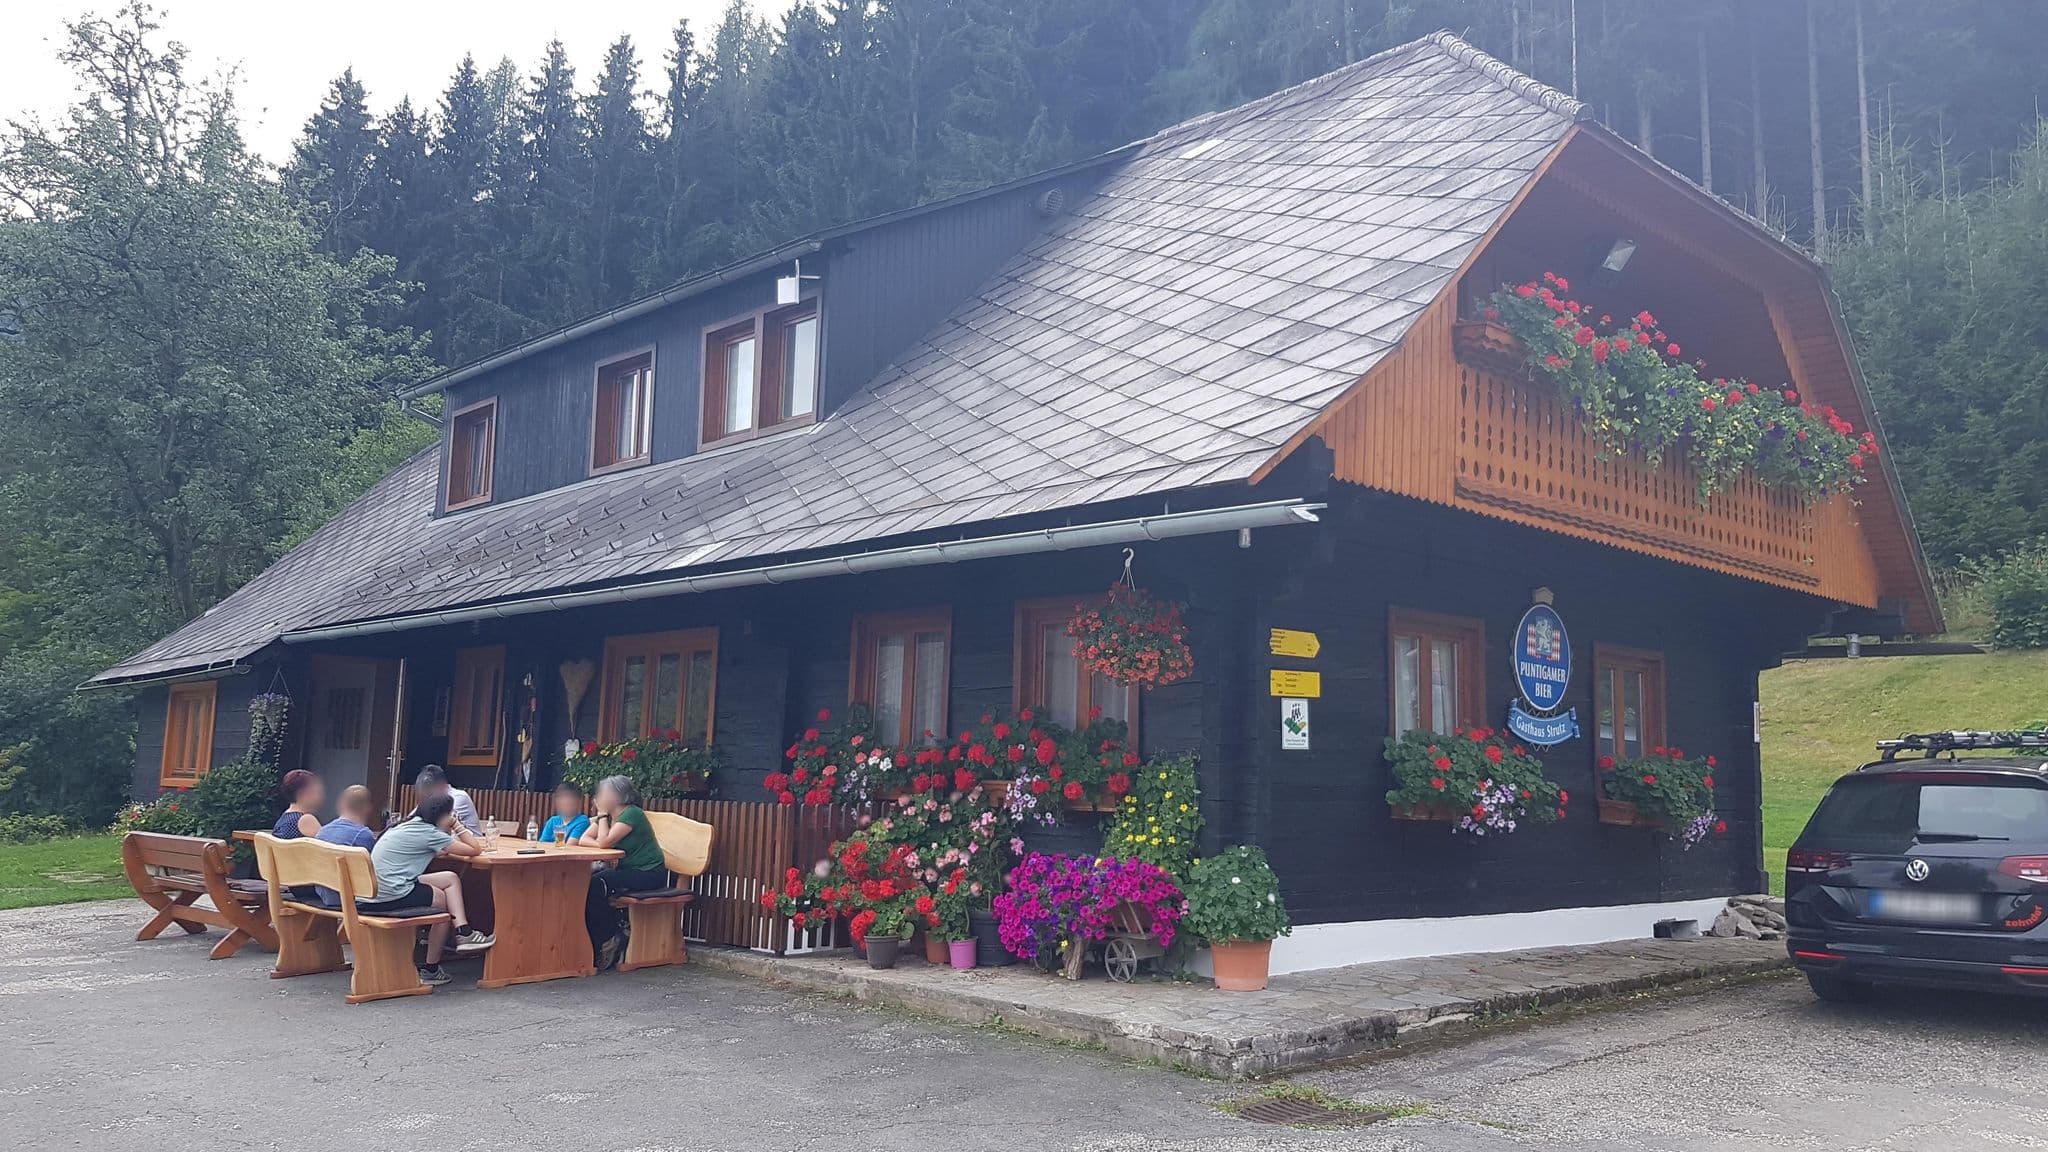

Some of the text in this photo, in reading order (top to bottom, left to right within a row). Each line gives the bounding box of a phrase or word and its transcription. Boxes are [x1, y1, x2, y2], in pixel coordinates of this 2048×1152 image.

[1520, 661, 1566, 683] PUNTIGAMER
[1535, 683, 1552, 699] BIER
[1516, 716, 1566, 737] Gasthaus Strutz
